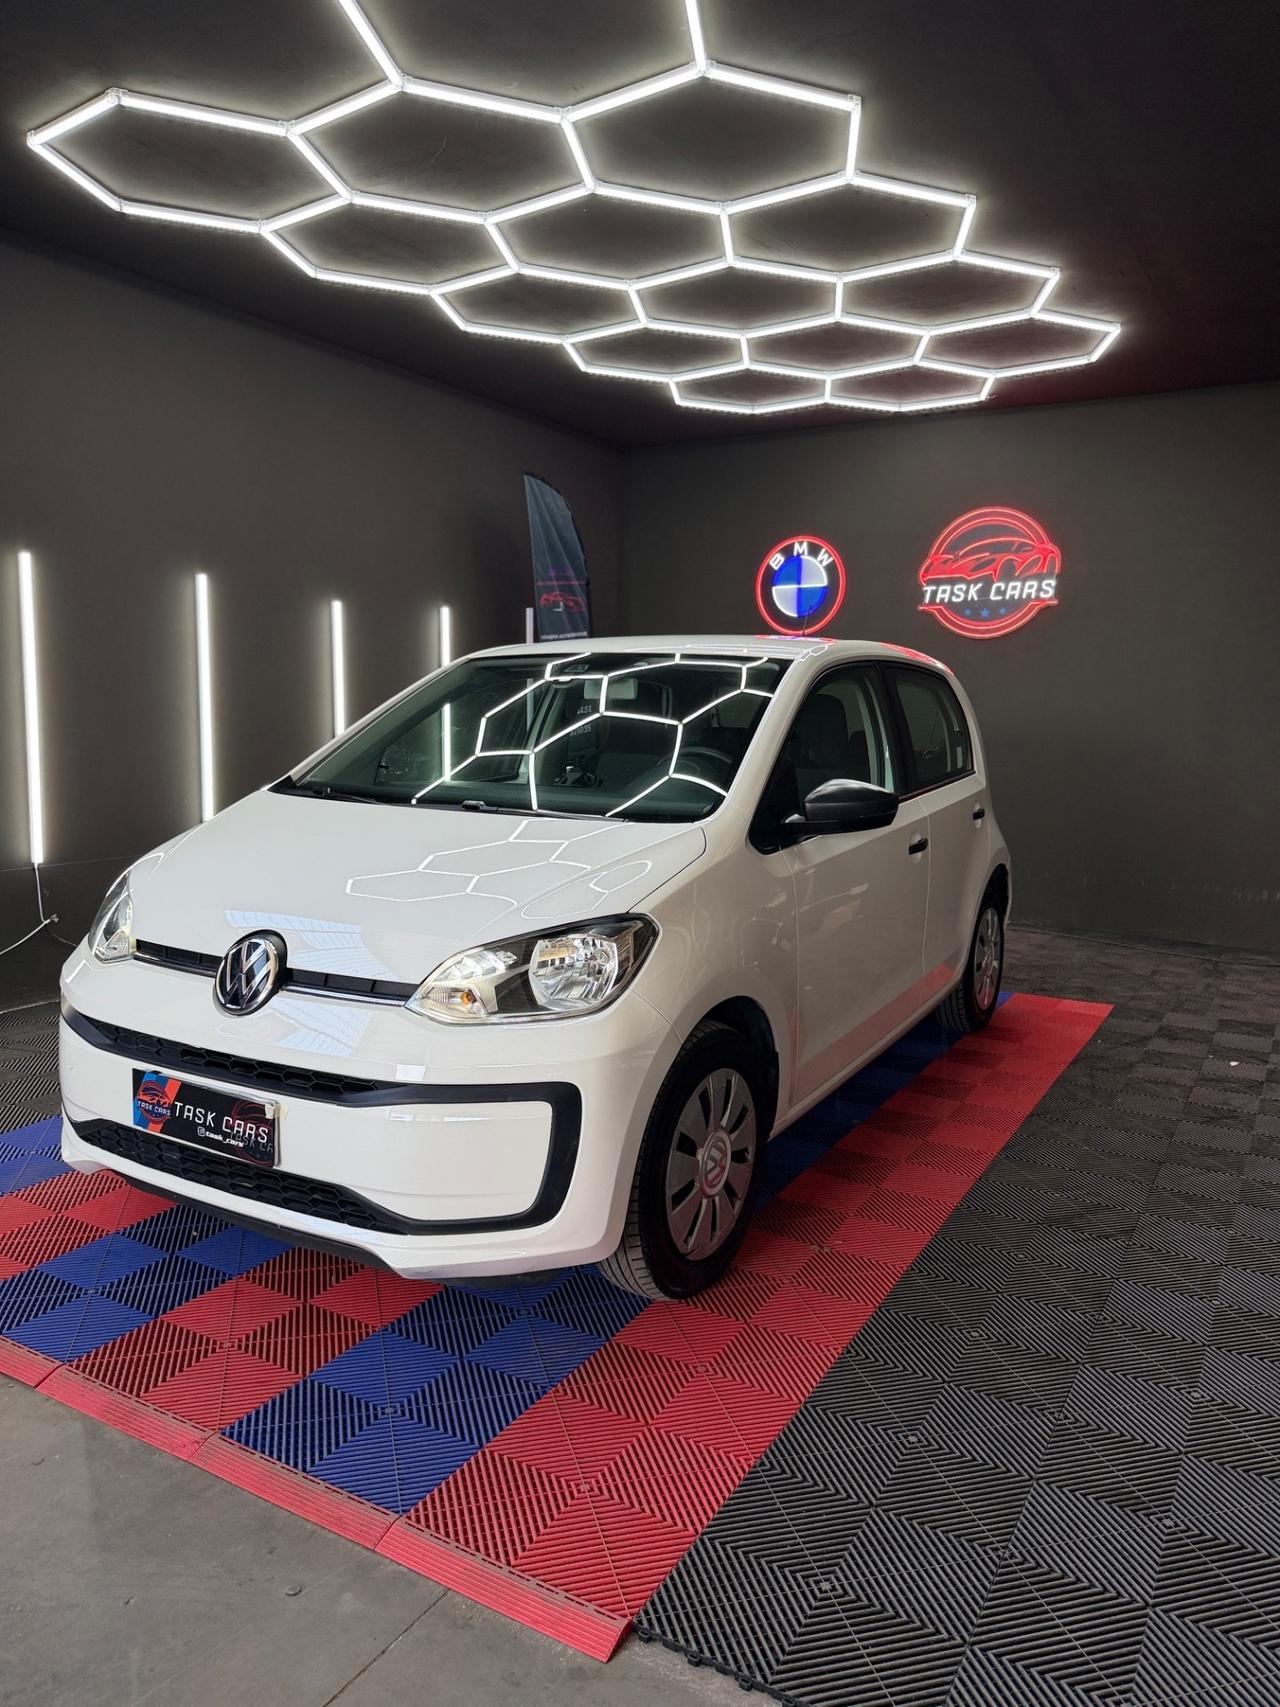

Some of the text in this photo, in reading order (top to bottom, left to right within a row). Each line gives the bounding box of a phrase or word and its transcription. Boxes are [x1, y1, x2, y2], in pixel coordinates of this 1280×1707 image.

[769, 541, 833, 570] BMW
[923, 579, 1056, 604] TASK CARS
[137, 1100, 171, 1117] TASK CARS
[174, 1101, 268, 1143] TASK CARS
